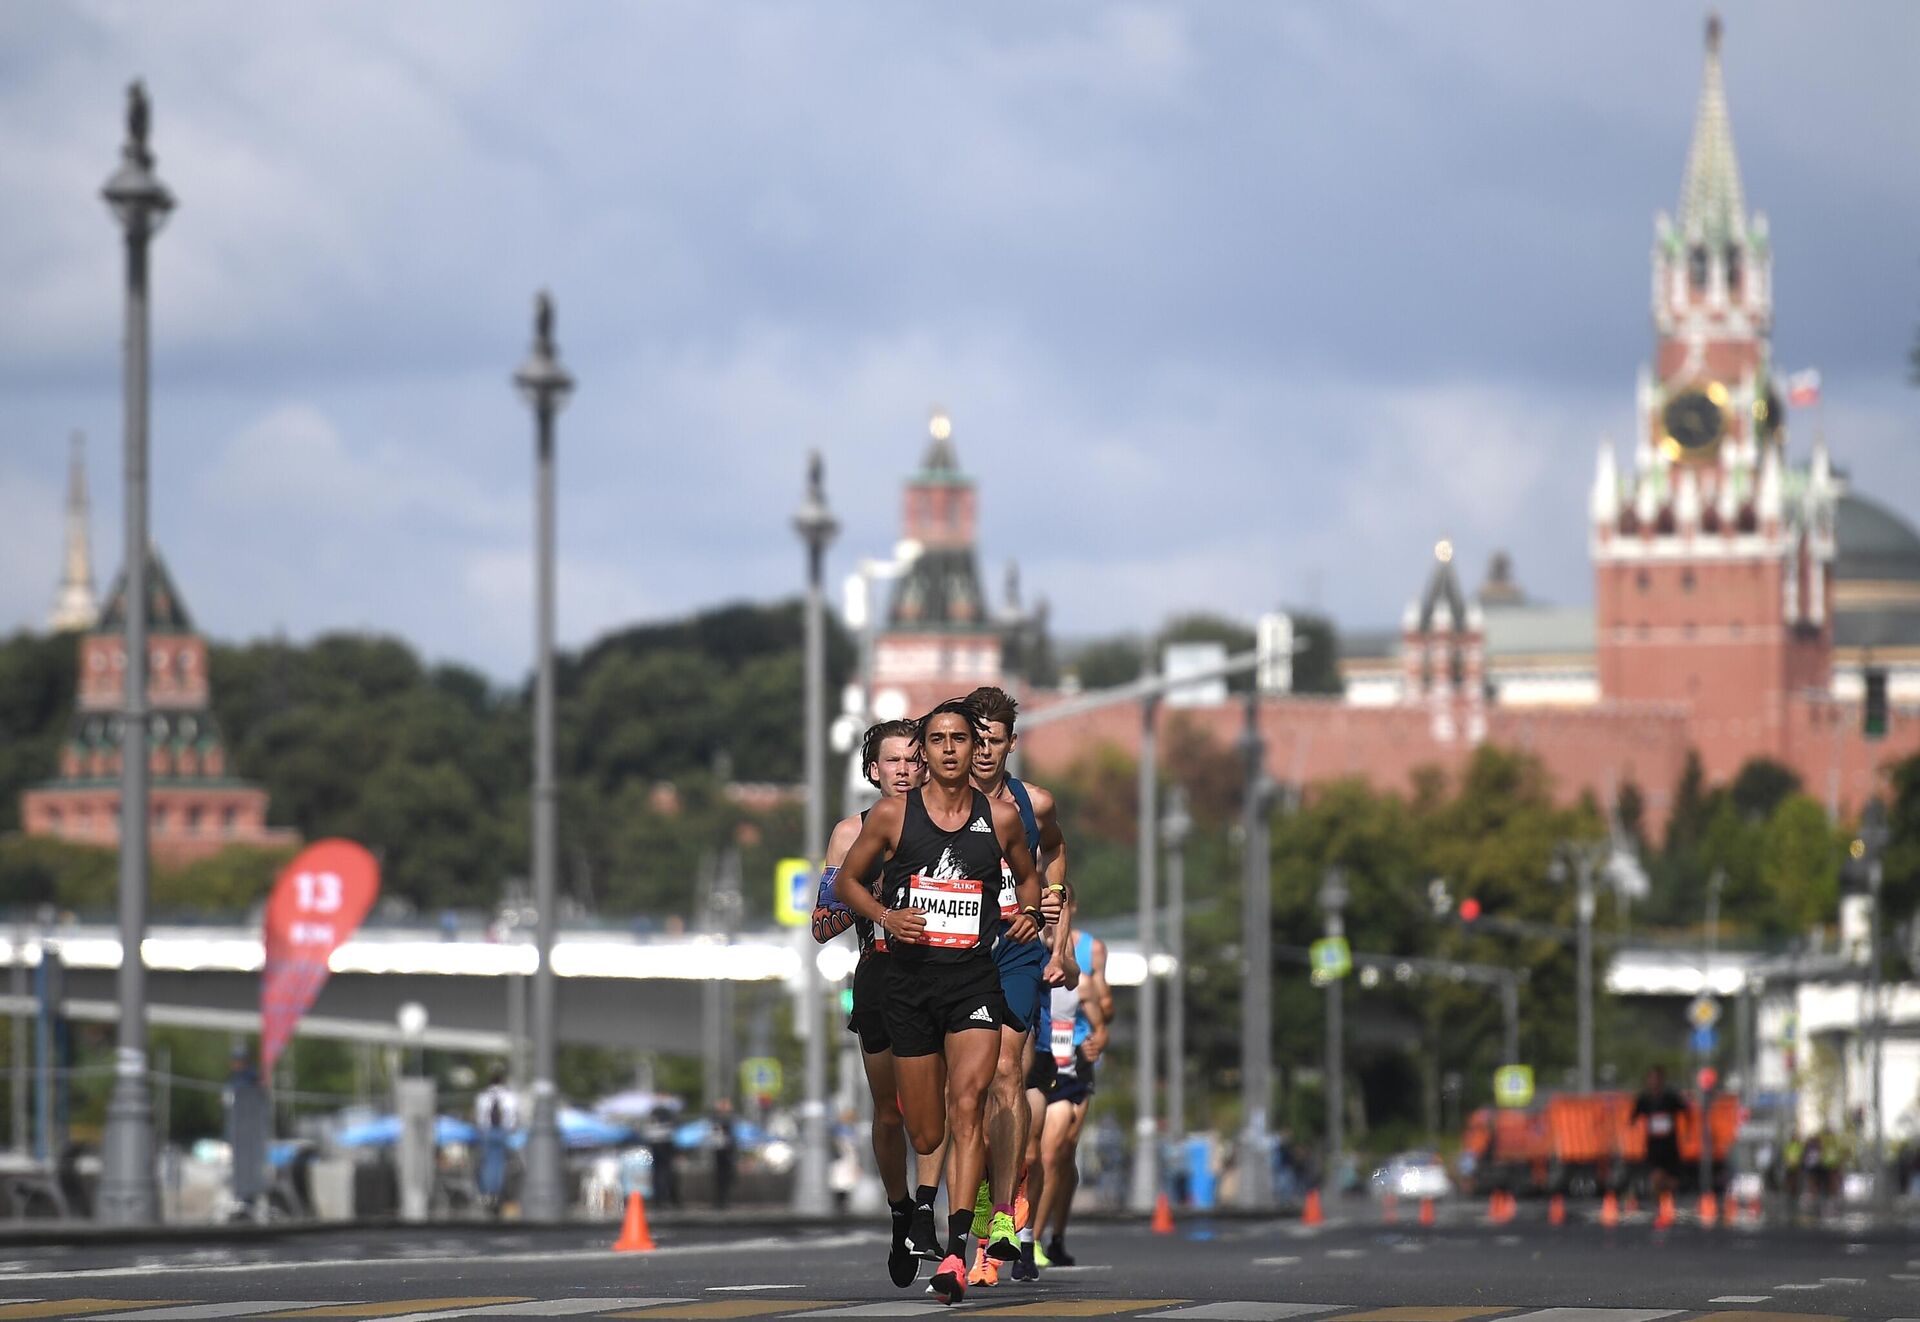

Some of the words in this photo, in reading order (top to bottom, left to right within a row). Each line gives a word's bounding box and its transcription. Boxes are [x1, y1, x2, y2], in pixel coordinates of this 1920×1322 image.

[294, 872, 342, 913] 13
[912, 895, 979, 918] АХМАДЕЕВ
[970, 1014, 993, 1023] adidas
